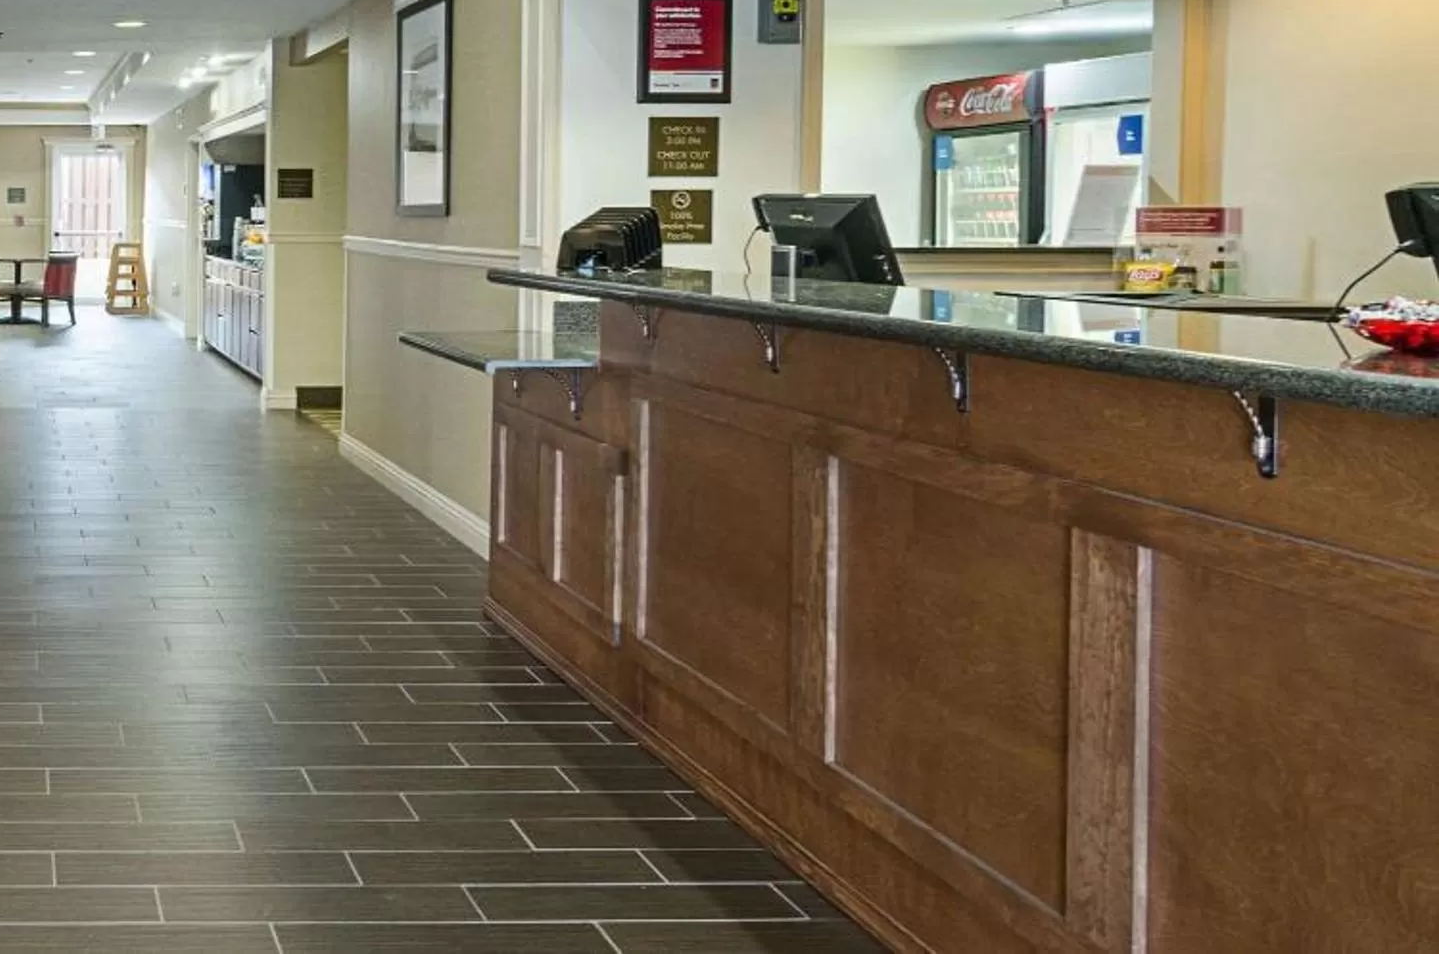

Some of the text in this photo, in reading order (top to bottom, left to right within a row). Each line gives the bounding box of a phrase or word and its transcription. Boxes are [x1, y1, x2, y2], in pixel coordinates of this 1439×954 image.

[662, 125, 694, 135] CHECK
[687, 135, 702, 145] PM
[657, 150, 711, 160] CHECK OUT
[689, 161, 705, 171] AM
